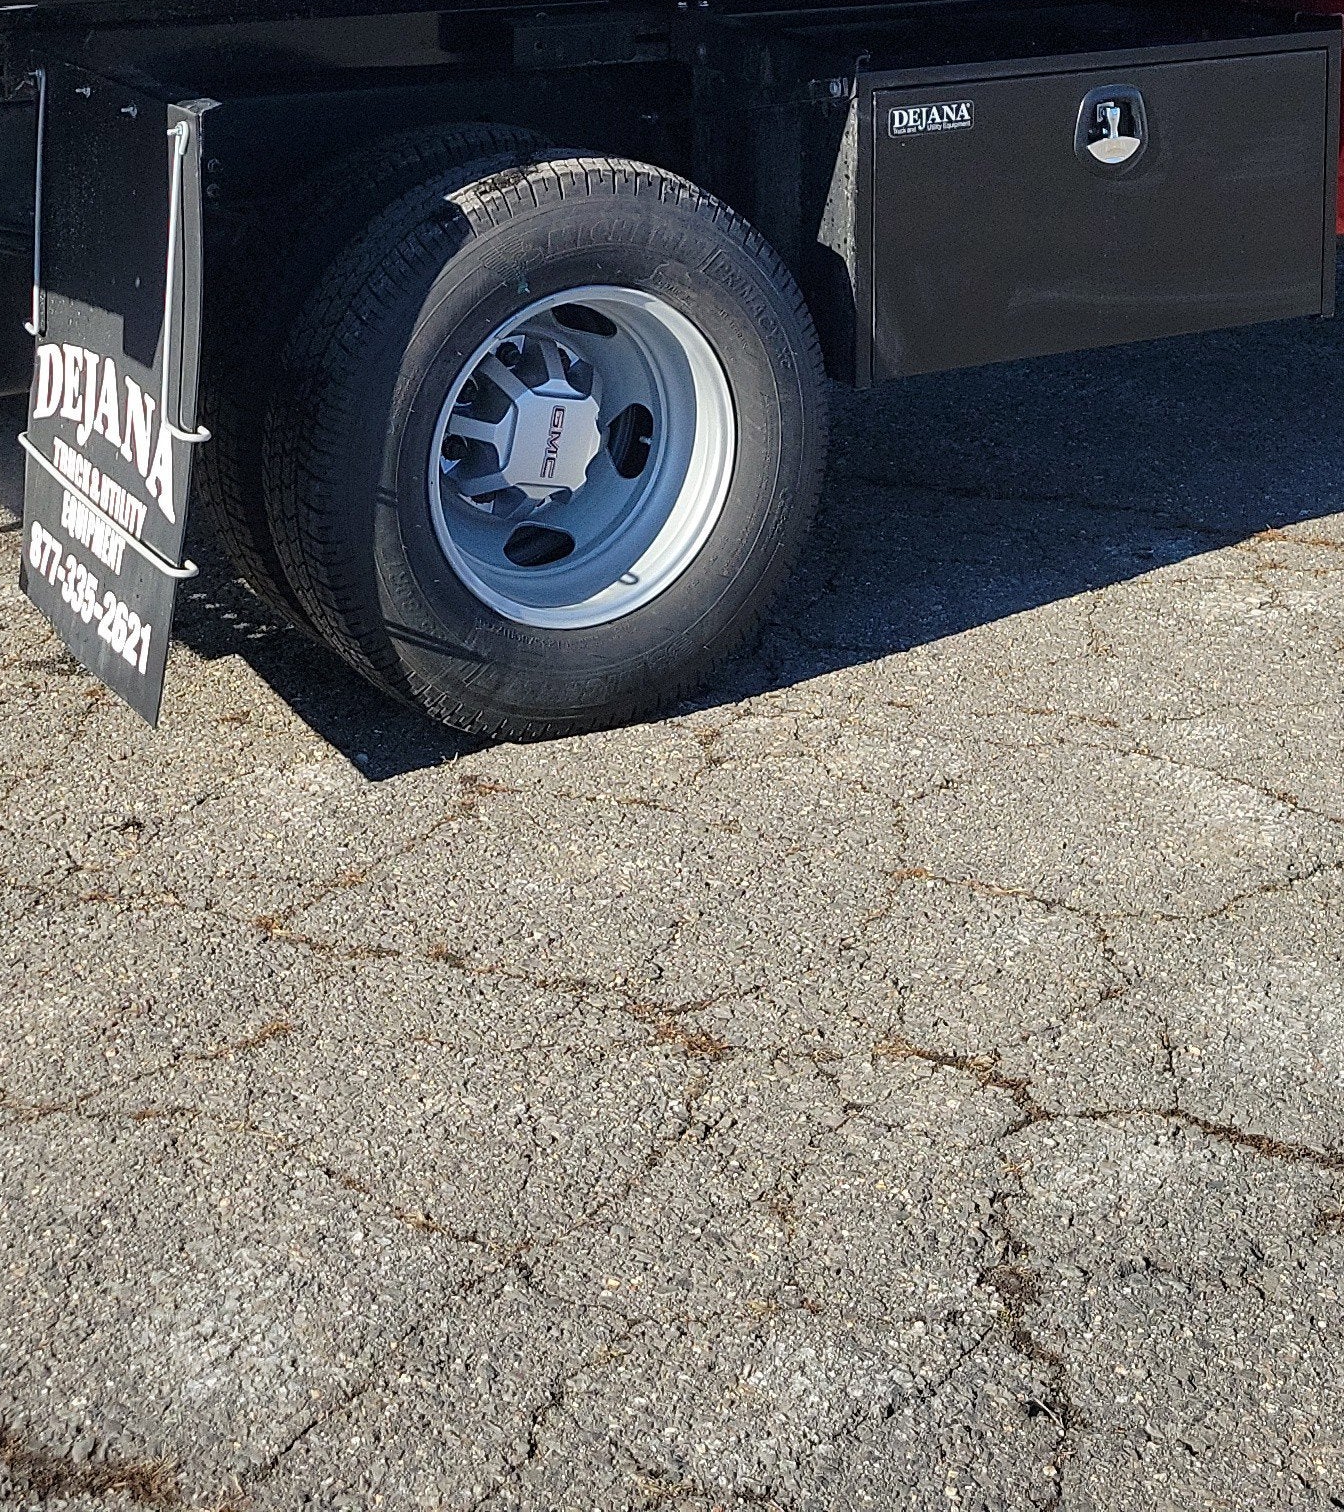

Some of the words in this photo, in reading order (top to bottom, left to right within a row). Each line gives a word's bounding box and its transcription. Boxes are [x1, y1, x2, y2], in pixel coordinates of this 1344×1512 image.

[892, 102, 971, 130] DEJANA
[33, 342, 176, 524] DEJANA
[540, 405, 566, 478] GMC
[53, 436, 92, 497] TRUCK
[99, 473, 148, 541] UTILITY
[61, 489, 126, 576] EQUIPMENT
[29, 520, 152, 675] 877-335-2621
